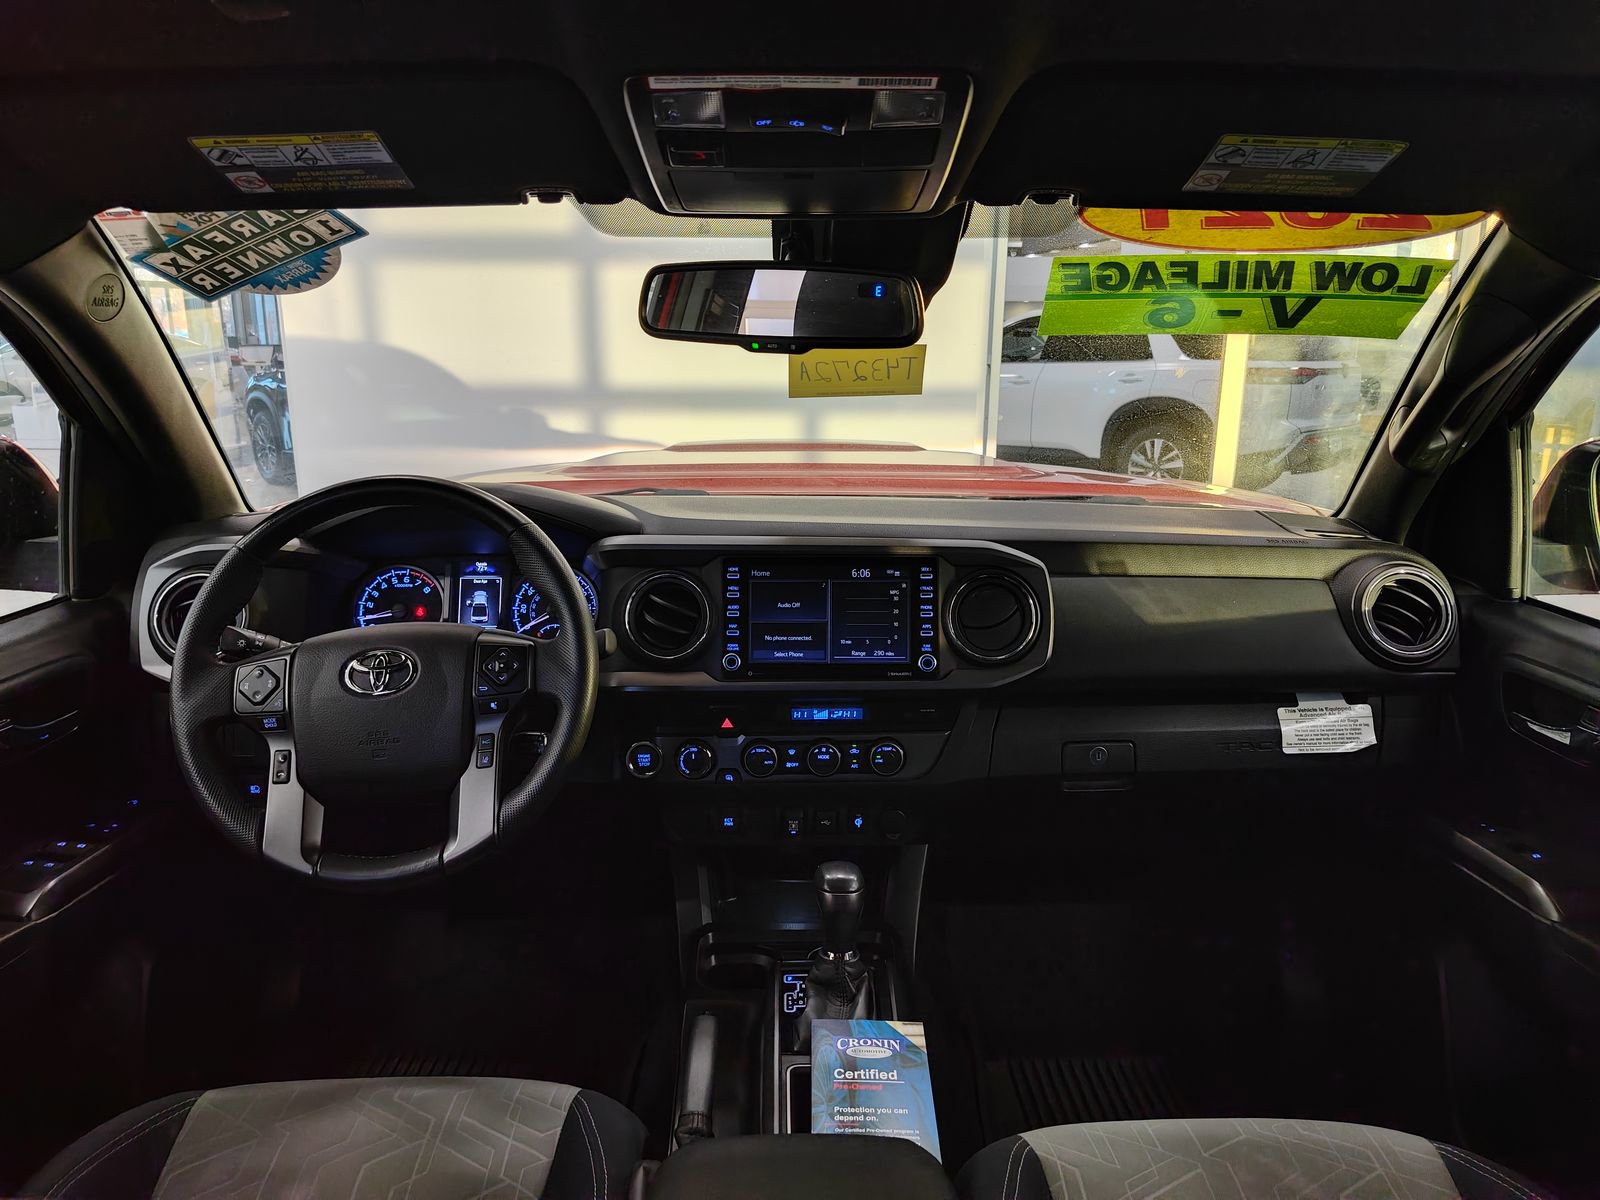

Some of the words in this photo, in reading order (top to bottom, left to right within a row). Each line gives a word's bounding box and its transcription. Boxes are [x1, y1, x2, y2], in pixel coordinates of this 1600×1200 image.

[875, 286, 882, 296] E
[91, 297, 119, 307] AIRBAG
[851, 568, 871, 578] 6:06
[391, 577, 398, 585] 5
[414, 579, 422, 587] 7
[380, 582, 388, 590] 4
[423, 586, 431, 594] 8
[371, 590, 380, 598] 3
[366, 601, 374, 609] 2
[520, 603, 527, 614] 20
[843, 710, 857, 718] HI
[837, 1038, 900, 1051] CRONIN
[834, 1068, 897, 1080] Certified
[834, 1114, 864, 1123] depend
